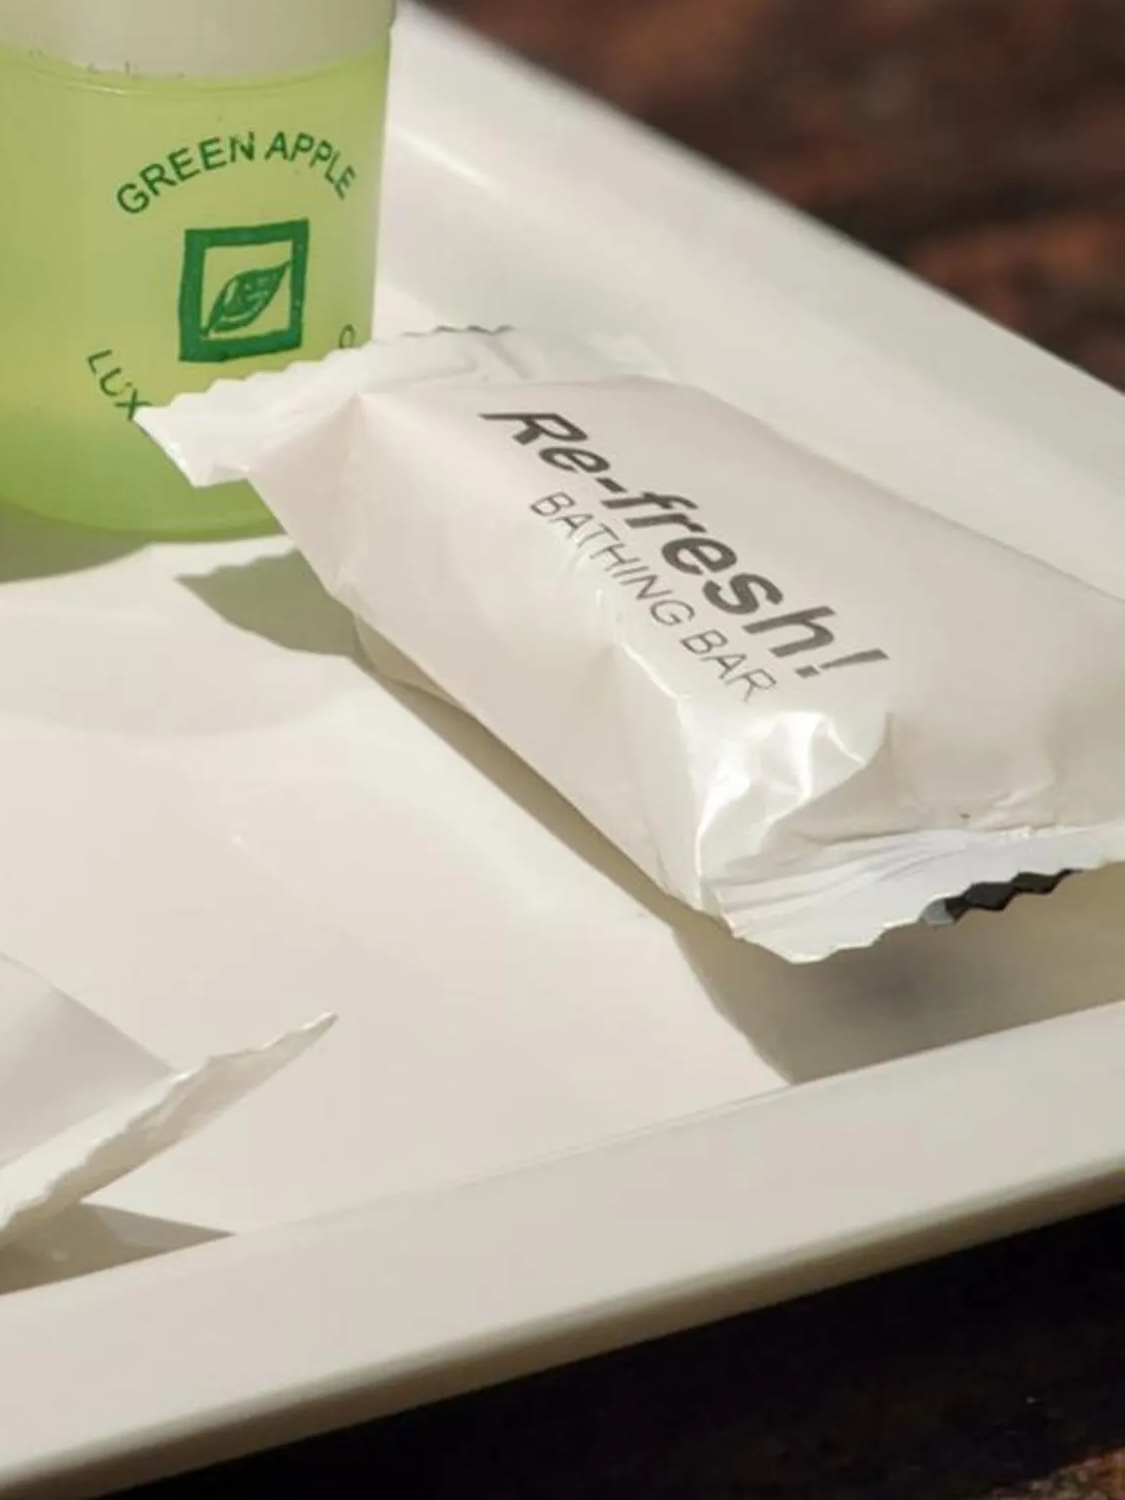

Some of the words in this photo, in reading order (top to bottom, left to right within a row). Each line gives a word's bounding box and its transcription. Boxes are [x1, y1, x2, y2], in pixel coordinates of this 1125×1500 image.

[116, 131, 255, 214] GREEN
[264, 131, 356, 200] APPLE
[477, 412, 890, 679] Re-fresh!
[529, 491, 695, 627] BATHING
[680, 629, 779, 701] BAR
